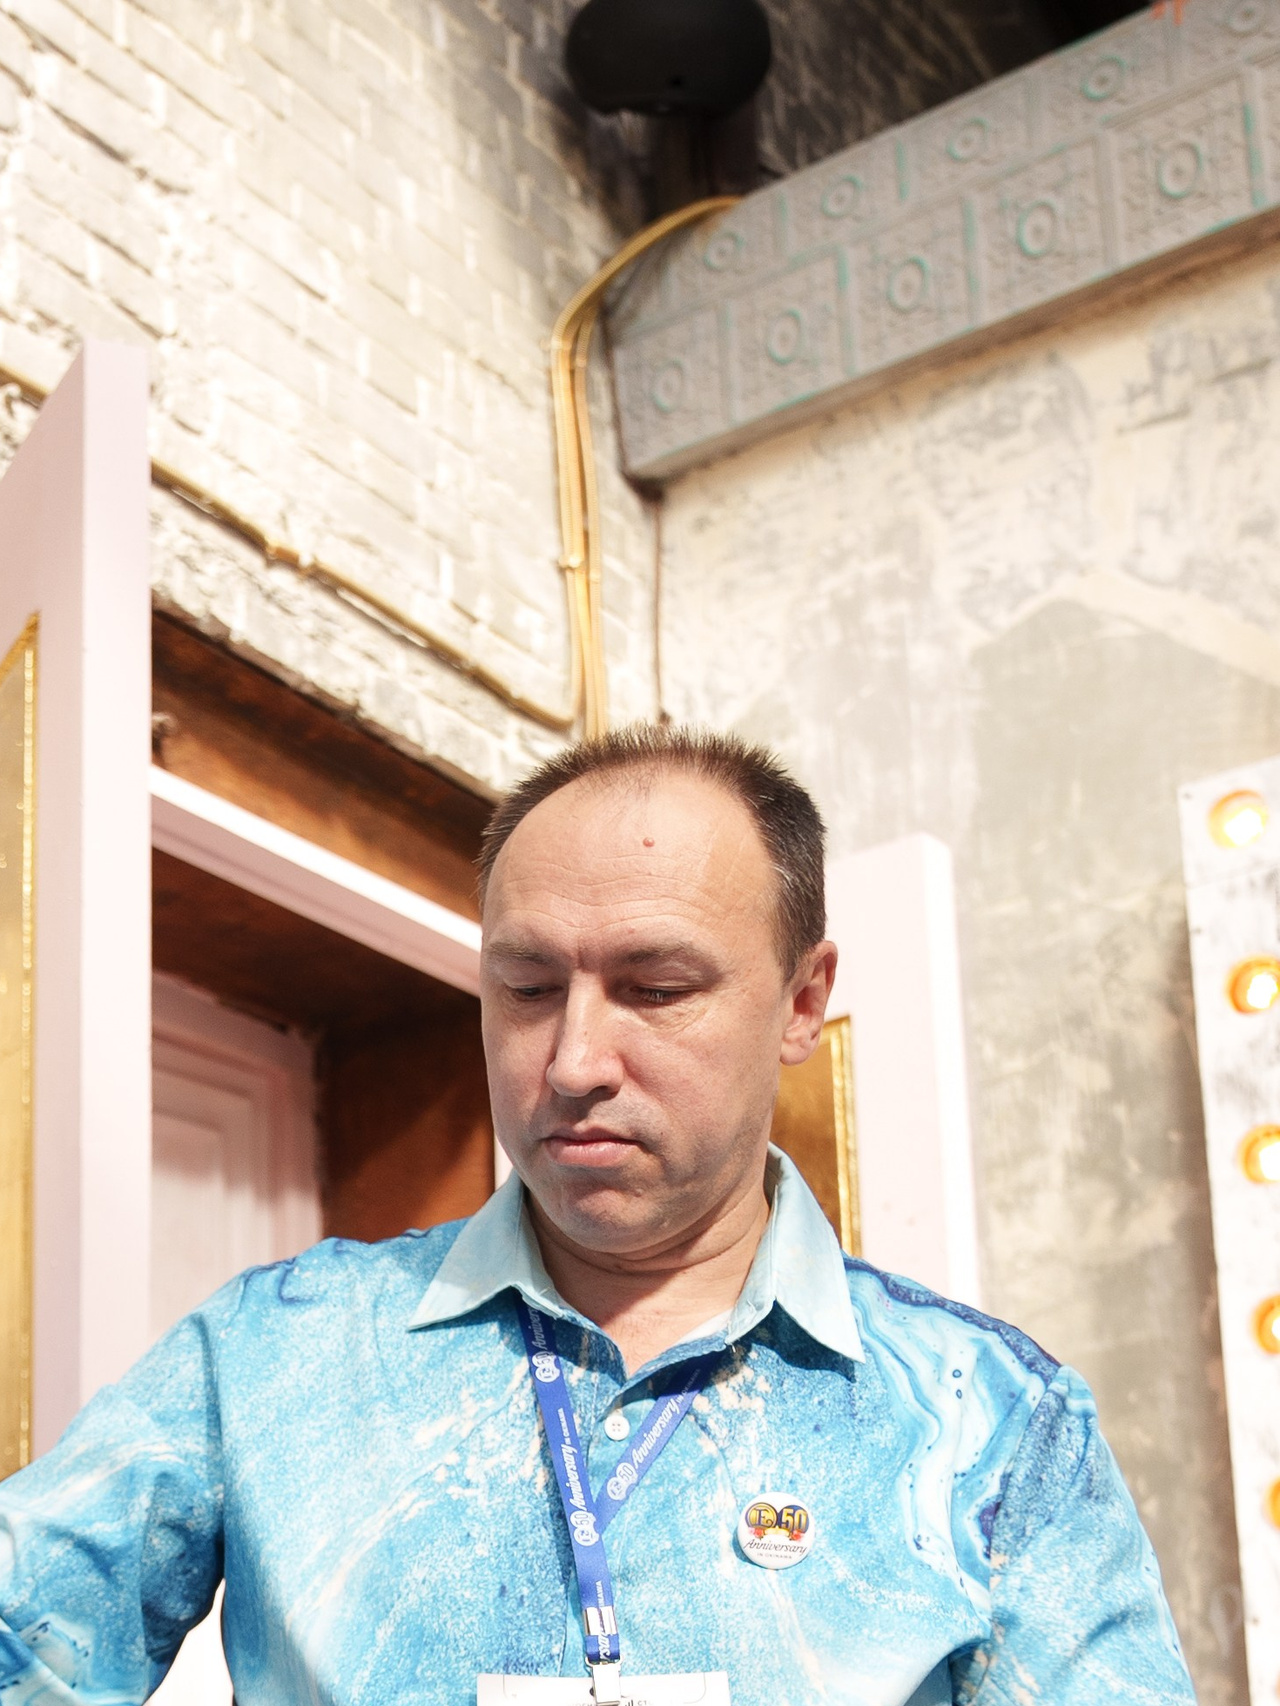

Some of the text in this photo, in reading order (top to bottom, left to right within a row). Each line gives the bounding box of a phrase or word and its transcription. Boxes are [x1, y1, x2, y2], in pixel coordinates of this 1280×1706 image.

[631, 1398, 680, 1470] Anniversary
[781, 1508, 808, 1533] 50
[743, 1538, 807, 1557] Anniversary
